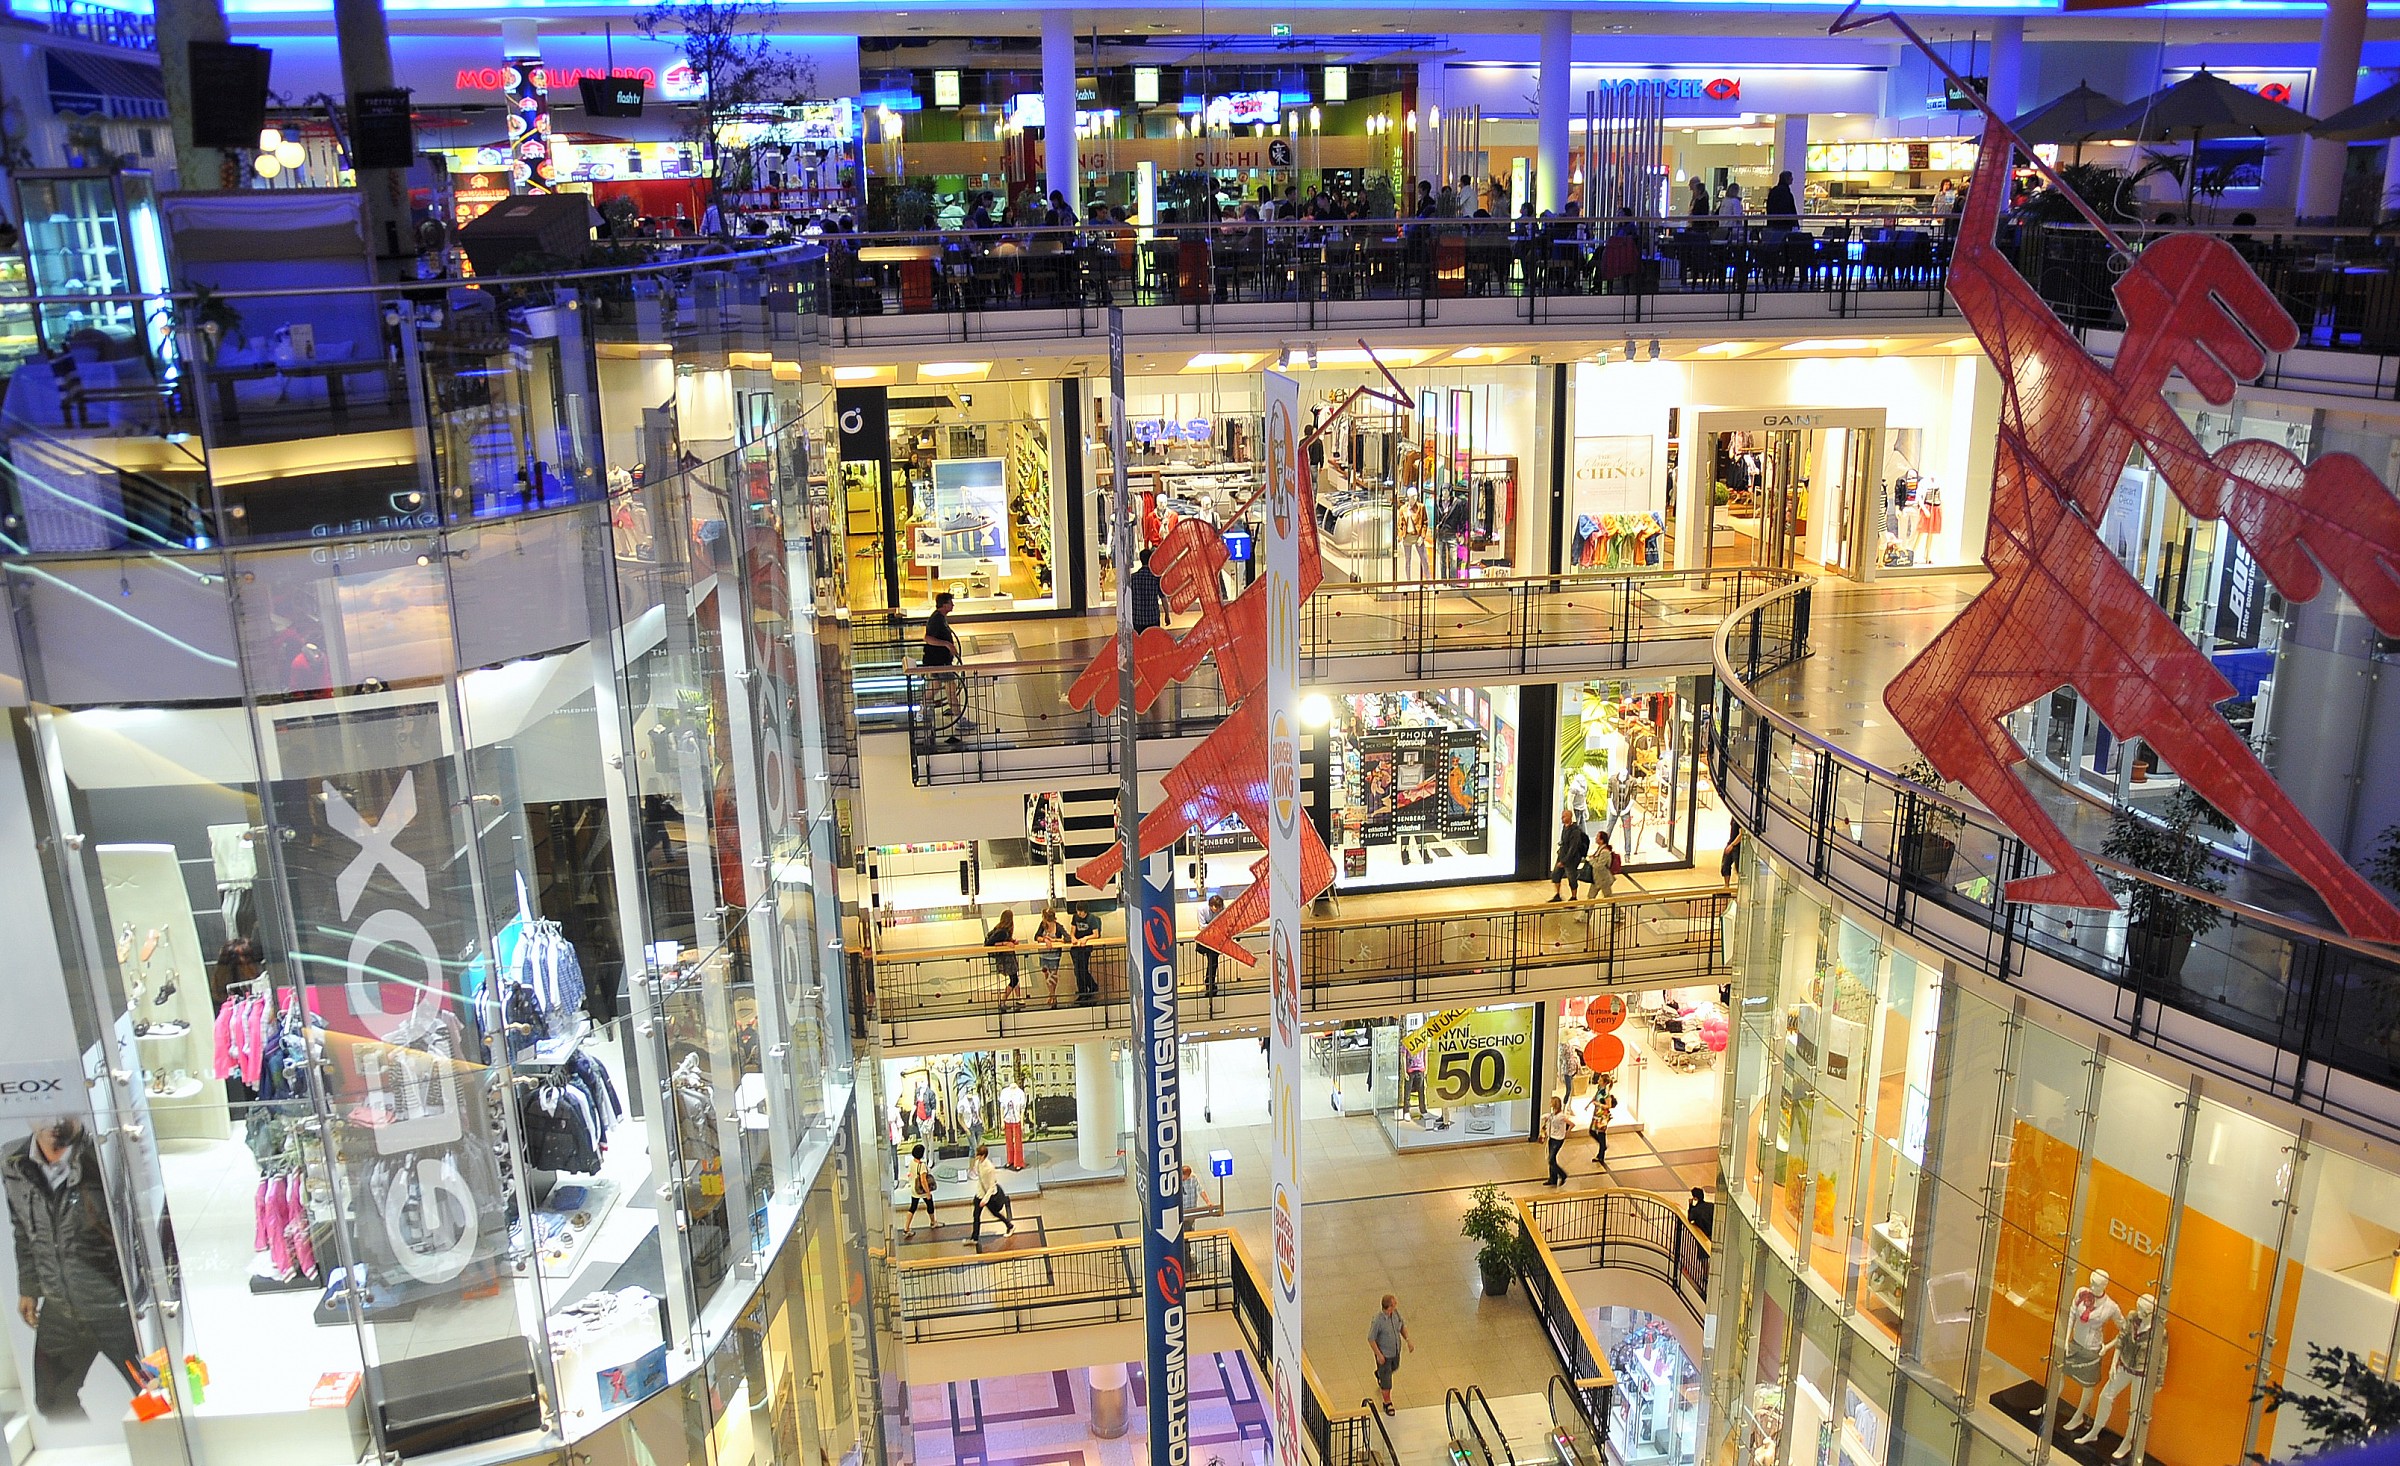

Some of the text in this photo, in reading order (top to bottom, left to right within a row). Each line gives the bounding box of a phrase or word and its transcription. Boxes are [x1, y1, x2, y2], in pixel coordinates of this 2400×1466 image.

[617, 90, 632, 104] flash
[1195, 152, 1259, 168] SUSHI
[1763, 415, 1824, 426] GANT
[1576, 467, 1645, 480] CHINO
[2246, 579, 2255, 608] sound
[1273, 741, 1293, 766] BURGER
[1273, 765, 1294, 799] KING
[322, 769, 479, 1285] GEOX
[1596, 1016, 1617, 1024] ceny
[1438, 1033, 1525, 1052] NA VŠECHNO
[1151, 964, 1181, 1198] SPORTISIMO
[1275, 1207, 1295, 1240] BURGER
[1276, 1233, 1296, 1274] KING
